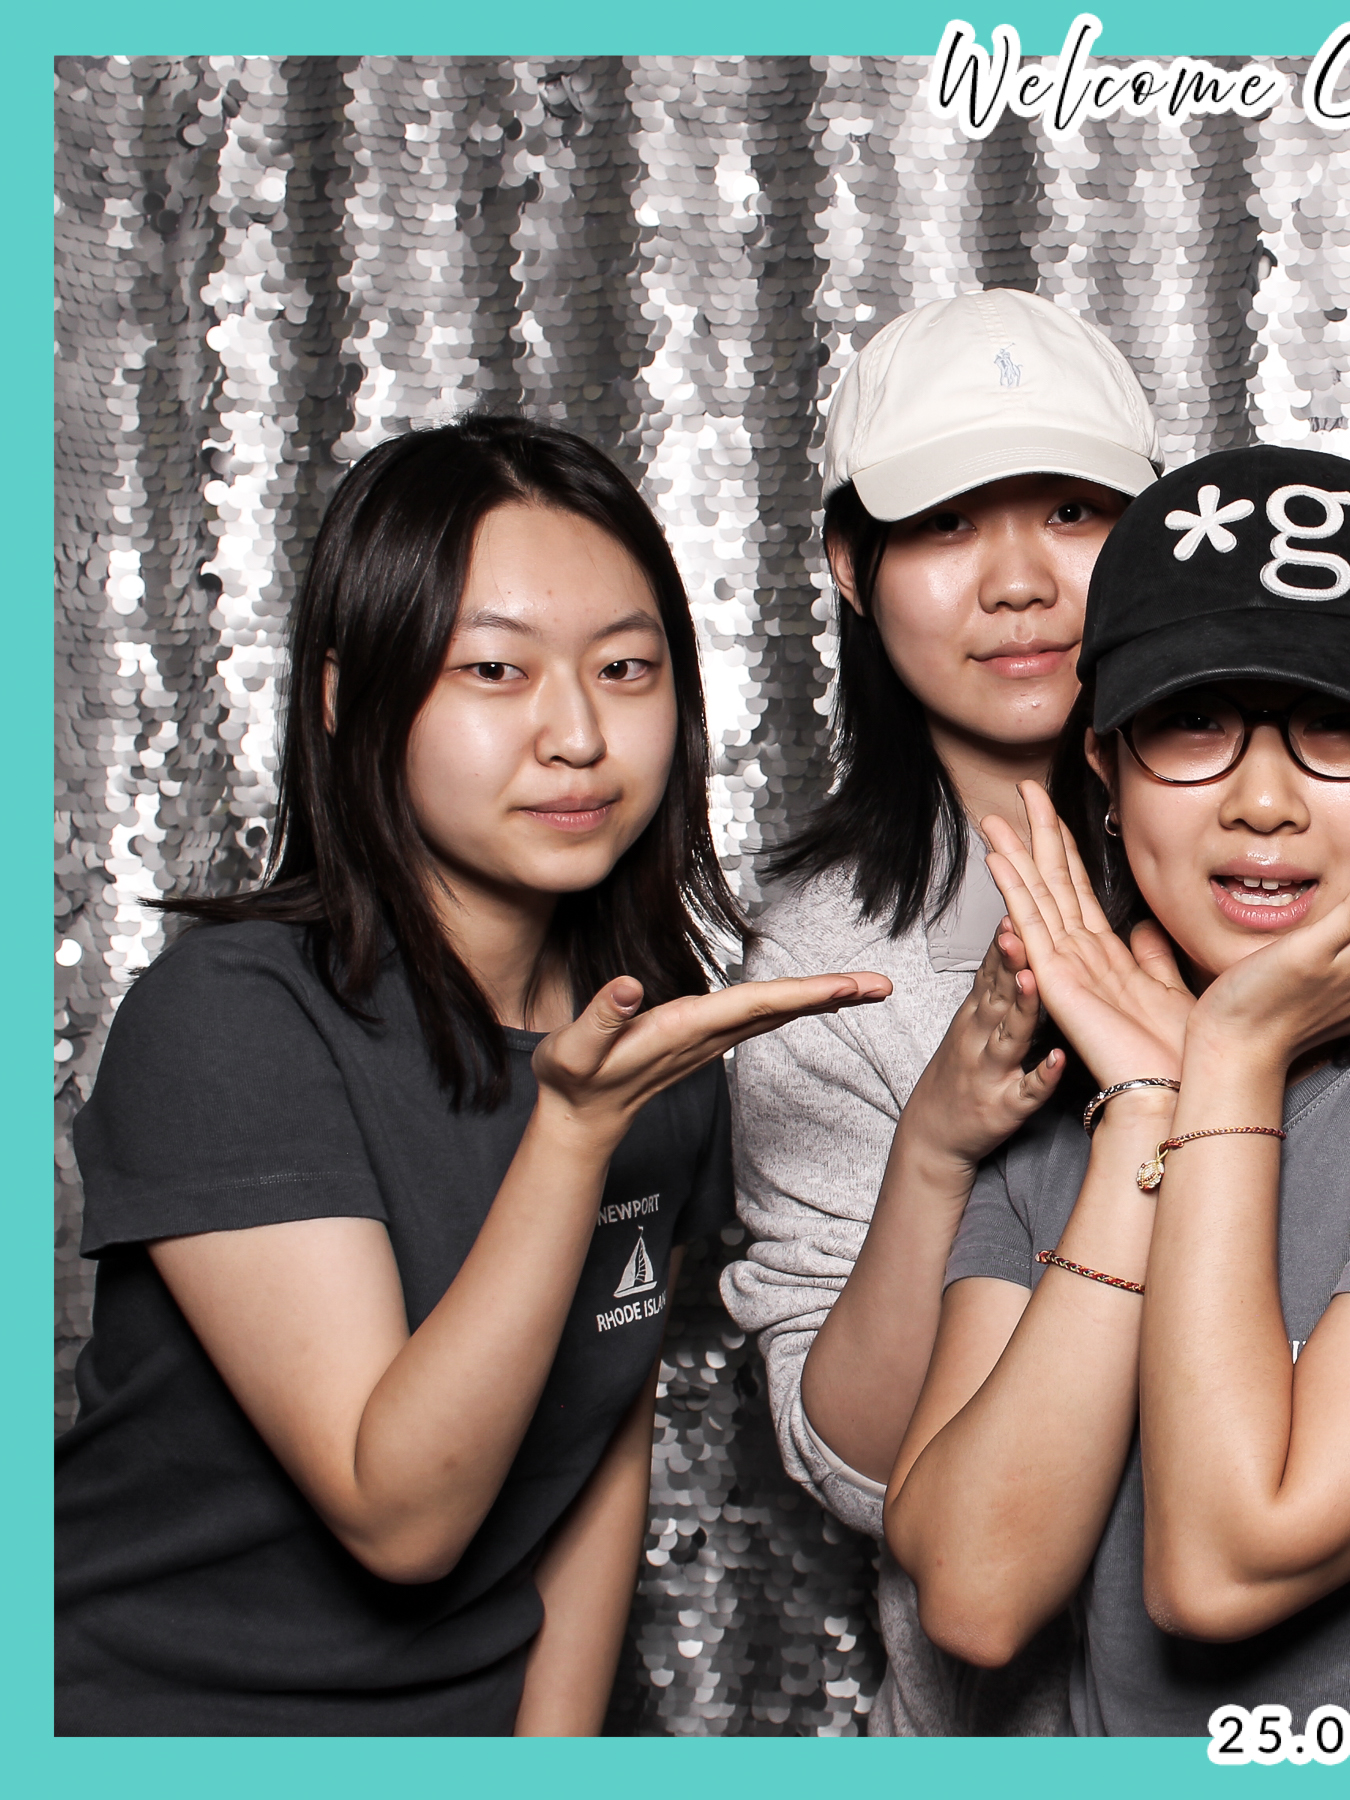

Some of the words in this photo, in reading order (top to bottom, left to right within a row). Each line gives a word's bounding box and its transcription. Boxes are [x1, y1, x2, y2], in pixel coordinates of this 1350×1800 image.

[597, 1193, 660, 1227] NEWPORT
[596, 1301, 642, 1332] RHODE
[643, 1288, 668, 1318] ISLAN
